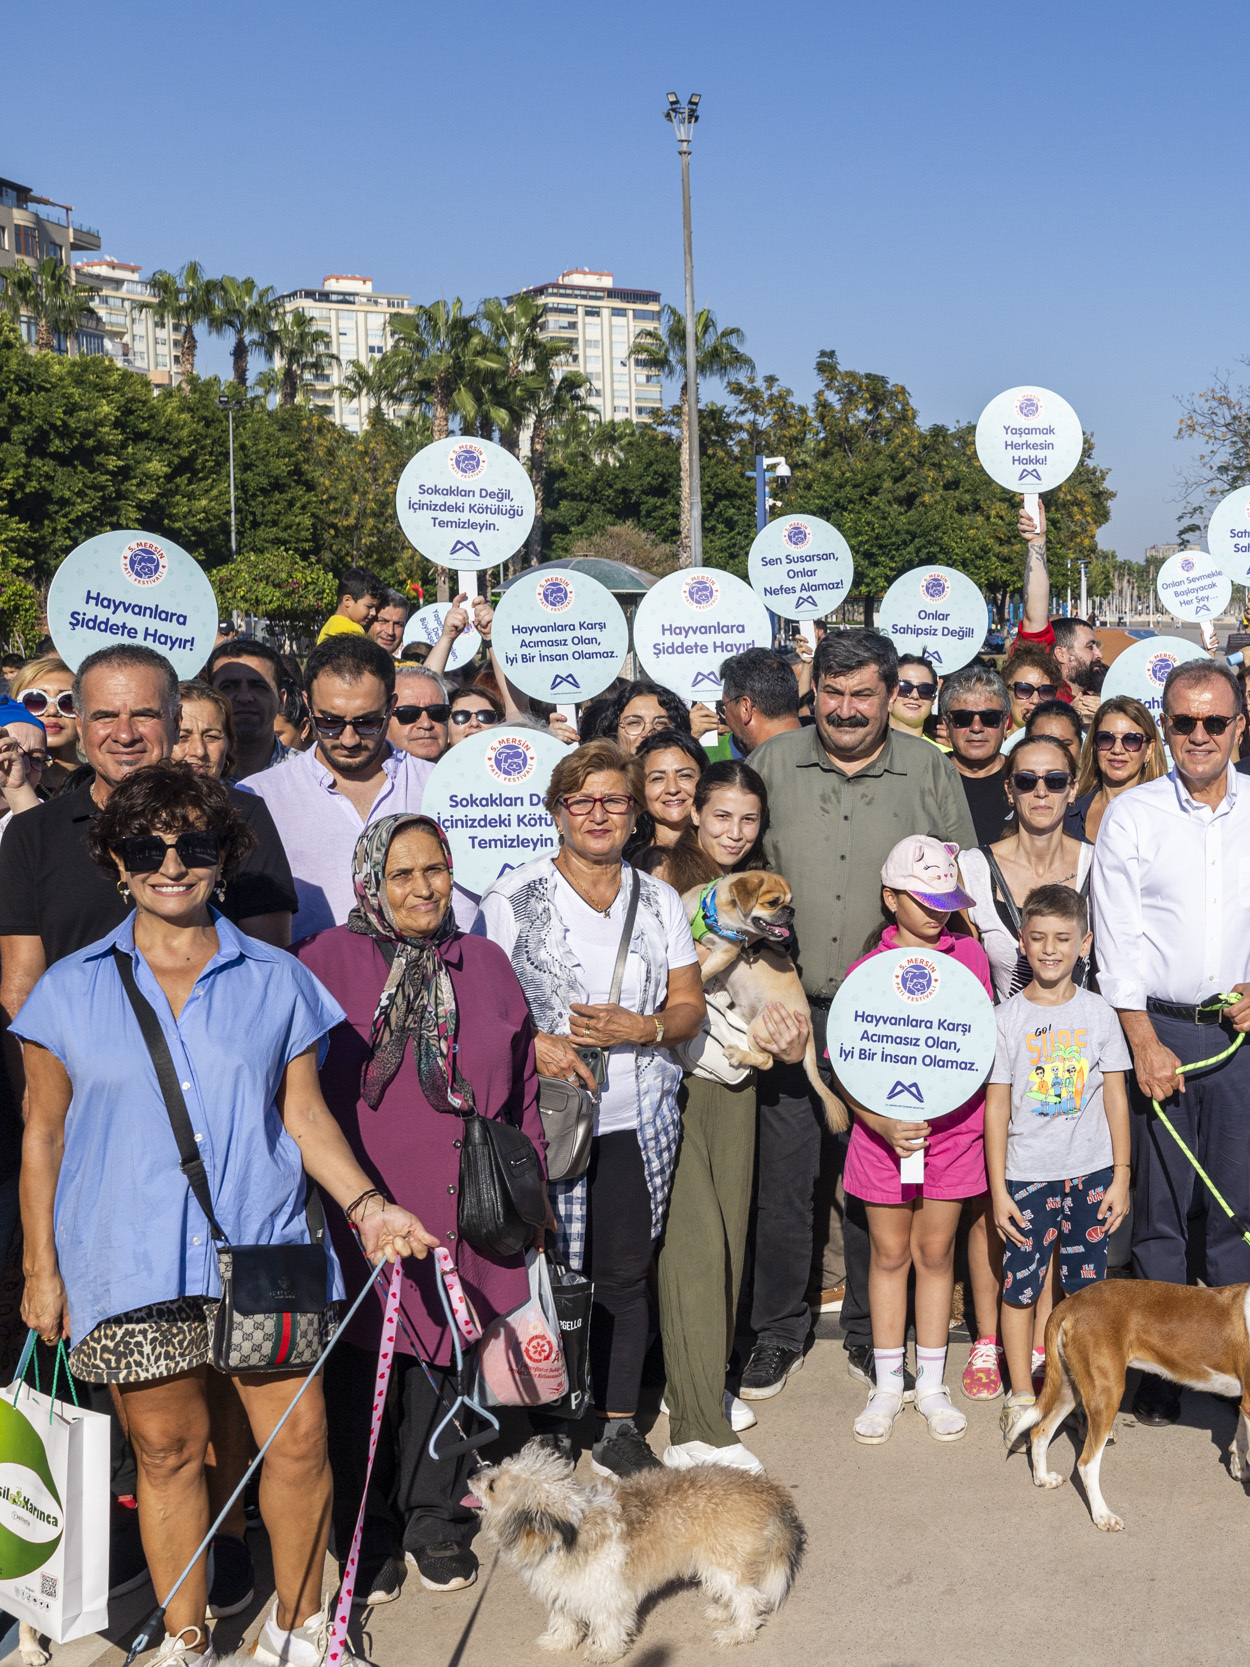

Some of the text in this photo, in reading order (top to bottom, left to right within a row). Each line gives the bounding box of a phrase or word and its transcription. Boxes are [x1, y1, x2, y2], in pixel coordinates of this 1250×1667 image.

[1003, 425, 1055, 437] Yaşamak
[459, 444, 484, 456] MERSİN
[1005, 440, 1054, 450] Herkesin
[1012, 455, 1047, 465] Hakkı!
[418, 484, 514, 502] Sokakları Değil,
[409, 497, 524, 519] İçinizdeki Kötülüğü
[431, 517, 499, 533] Temizleyin.
[136, 542, 165, 559] MERSİN
[761, 552, 838, 567] Sen Susarsan,
[787, 567, 817, 579] Onlar
[1162, 570, 1223, 590] Onları Sevmekle
[545, 577, 570, 587] MERSİN
[764, 579, 844, 596] Nefes Alamaz!
[1174, 582, 1218, 597] Başlayacak
[85, 590, 188, 626] Hayvanlara
[1179, 599, 1193, 607] Her
[918, 610, 950, 621] Onlar
[69, 611, 195, 651] Şiddete Hayır!
[511, 621, 606, 636] Hayvanlara Karşı
[661, 622, 745, 639] Hayvanlara
[891, 624, 974, 640] Sahipsiz Değil!
[520, 636, 601, 648] Acımasız Olan,
[506, 650, 618, 666] İyi Bir İnsan Olamaz.
[653, 642, 708, 659] Şiddete
[498, 738, 531, 751] MERSİN
[449, 793, 523, 808] Sokakları
[437, 812, 554, 832] İçinizdeki Kötü
[907, 958, 936, 973] MERSİN
[854, 1010, 972, 1036] Hayvanlara Karşı
[1035, 1024, 1051, 1037] GO!
[860, 1030, 960, 1053] Acımasız Olan,
[839, 1043, 979, 1072] İyi Bir İnsan Olamaz.
[1087, 1189, 1106, 1204] DUN
